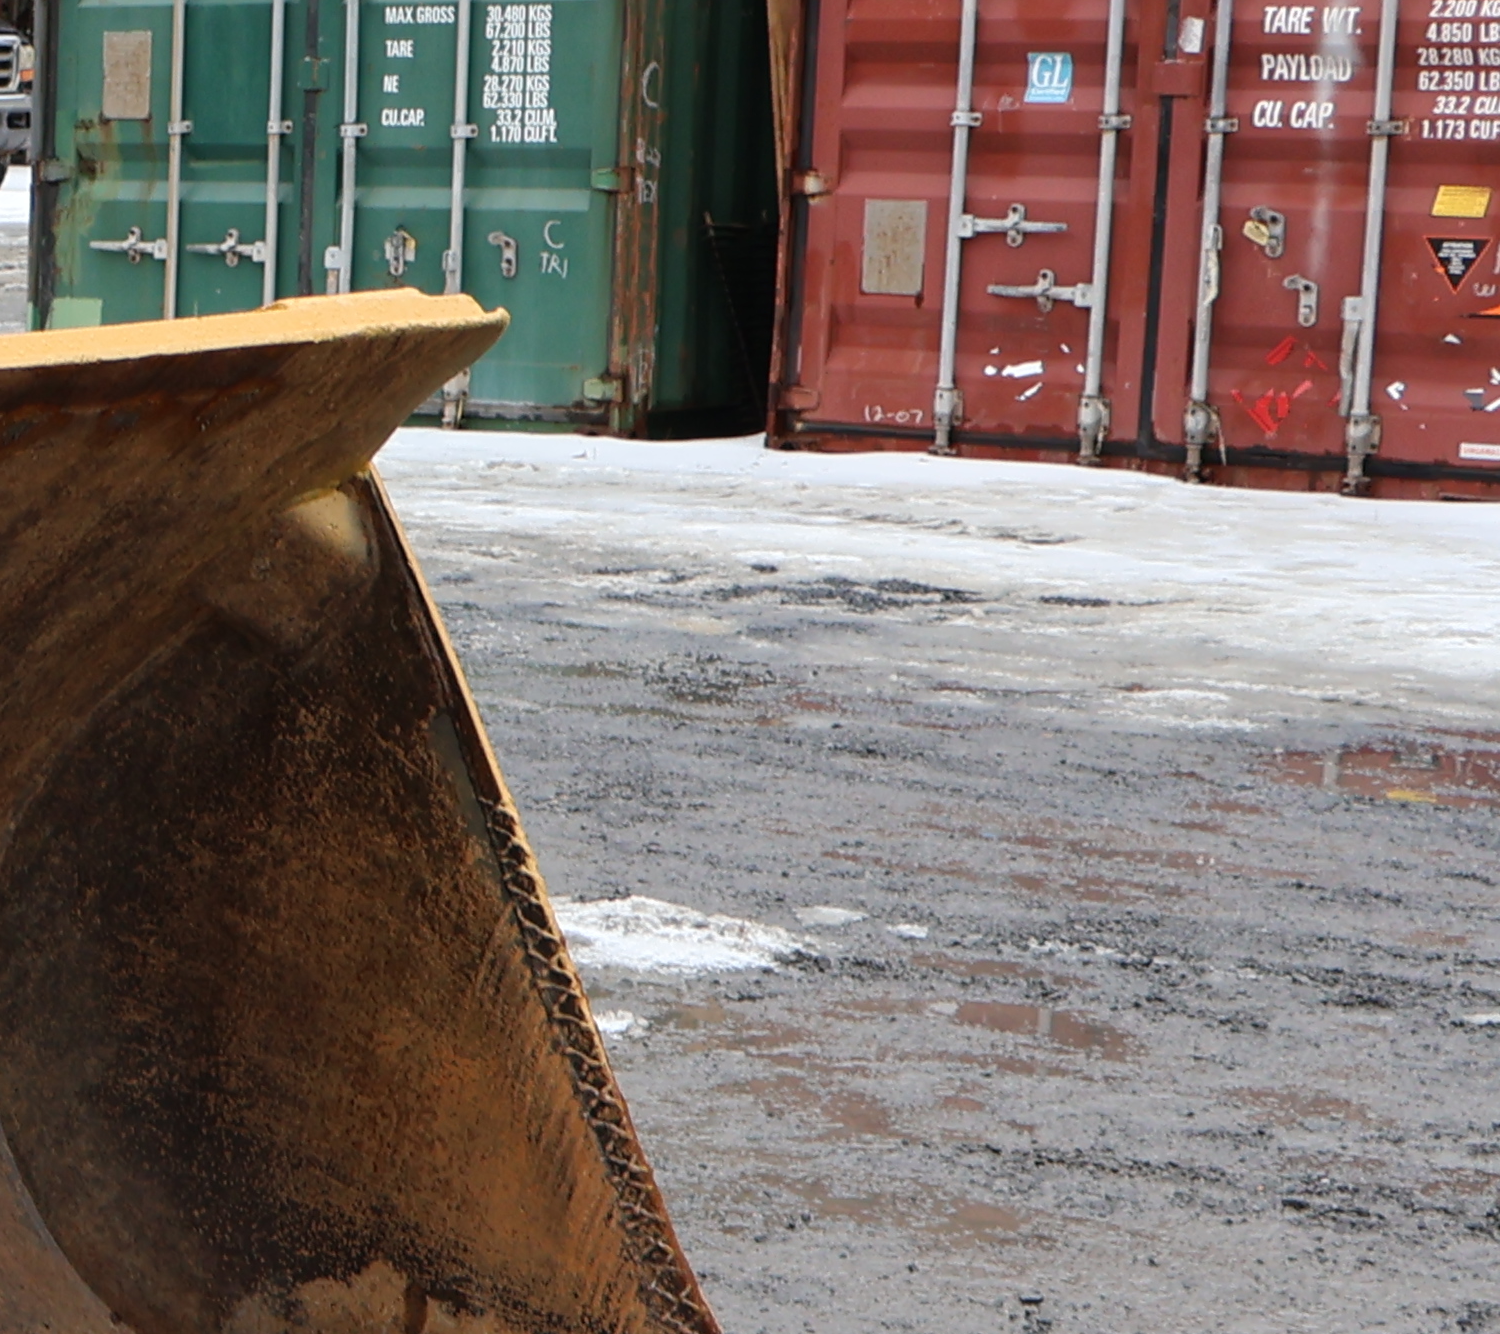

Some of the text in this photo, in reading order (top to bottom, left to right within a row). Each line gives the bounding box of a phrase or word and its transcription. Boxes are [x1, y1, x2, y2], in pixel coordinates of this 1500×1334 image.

[385, 5, 552, 24] MAX GROSS 30.480 KGS
[1263, 6, 1315, 34] TARE
[1322, 7, 1362, 34] WT.
[485, 21, 551, 39] 67.200 LBS
[1426, 22, 1473, 43] 4.850
[386, 39, 551, 58] TARE 2.210 KGS
[491, 56, 550, 73] 4.870 LBS
[1032, 55, 1069, 88] GL
[1261, 54, 1352, 82] PAYLOAD
[1417, 47, 1474, 66] 28.280
[483, 75, 523, 92] 28.270
[526, 75, 550, 91] KGS
[1418, 70, 1474, 91] 62.350
[483, 91, 548, 108] 62.330 LBS
[496, 109, 522, 126] 33.2
[1253, 101, 1283, 128] CU.
[1290, 101, 1335, 130] CAP.
[1432, 95, 1471, 115] 33.2
[490, 124, 520, 143] 1.170
[1421, 119, 1466, 140] 1.173
